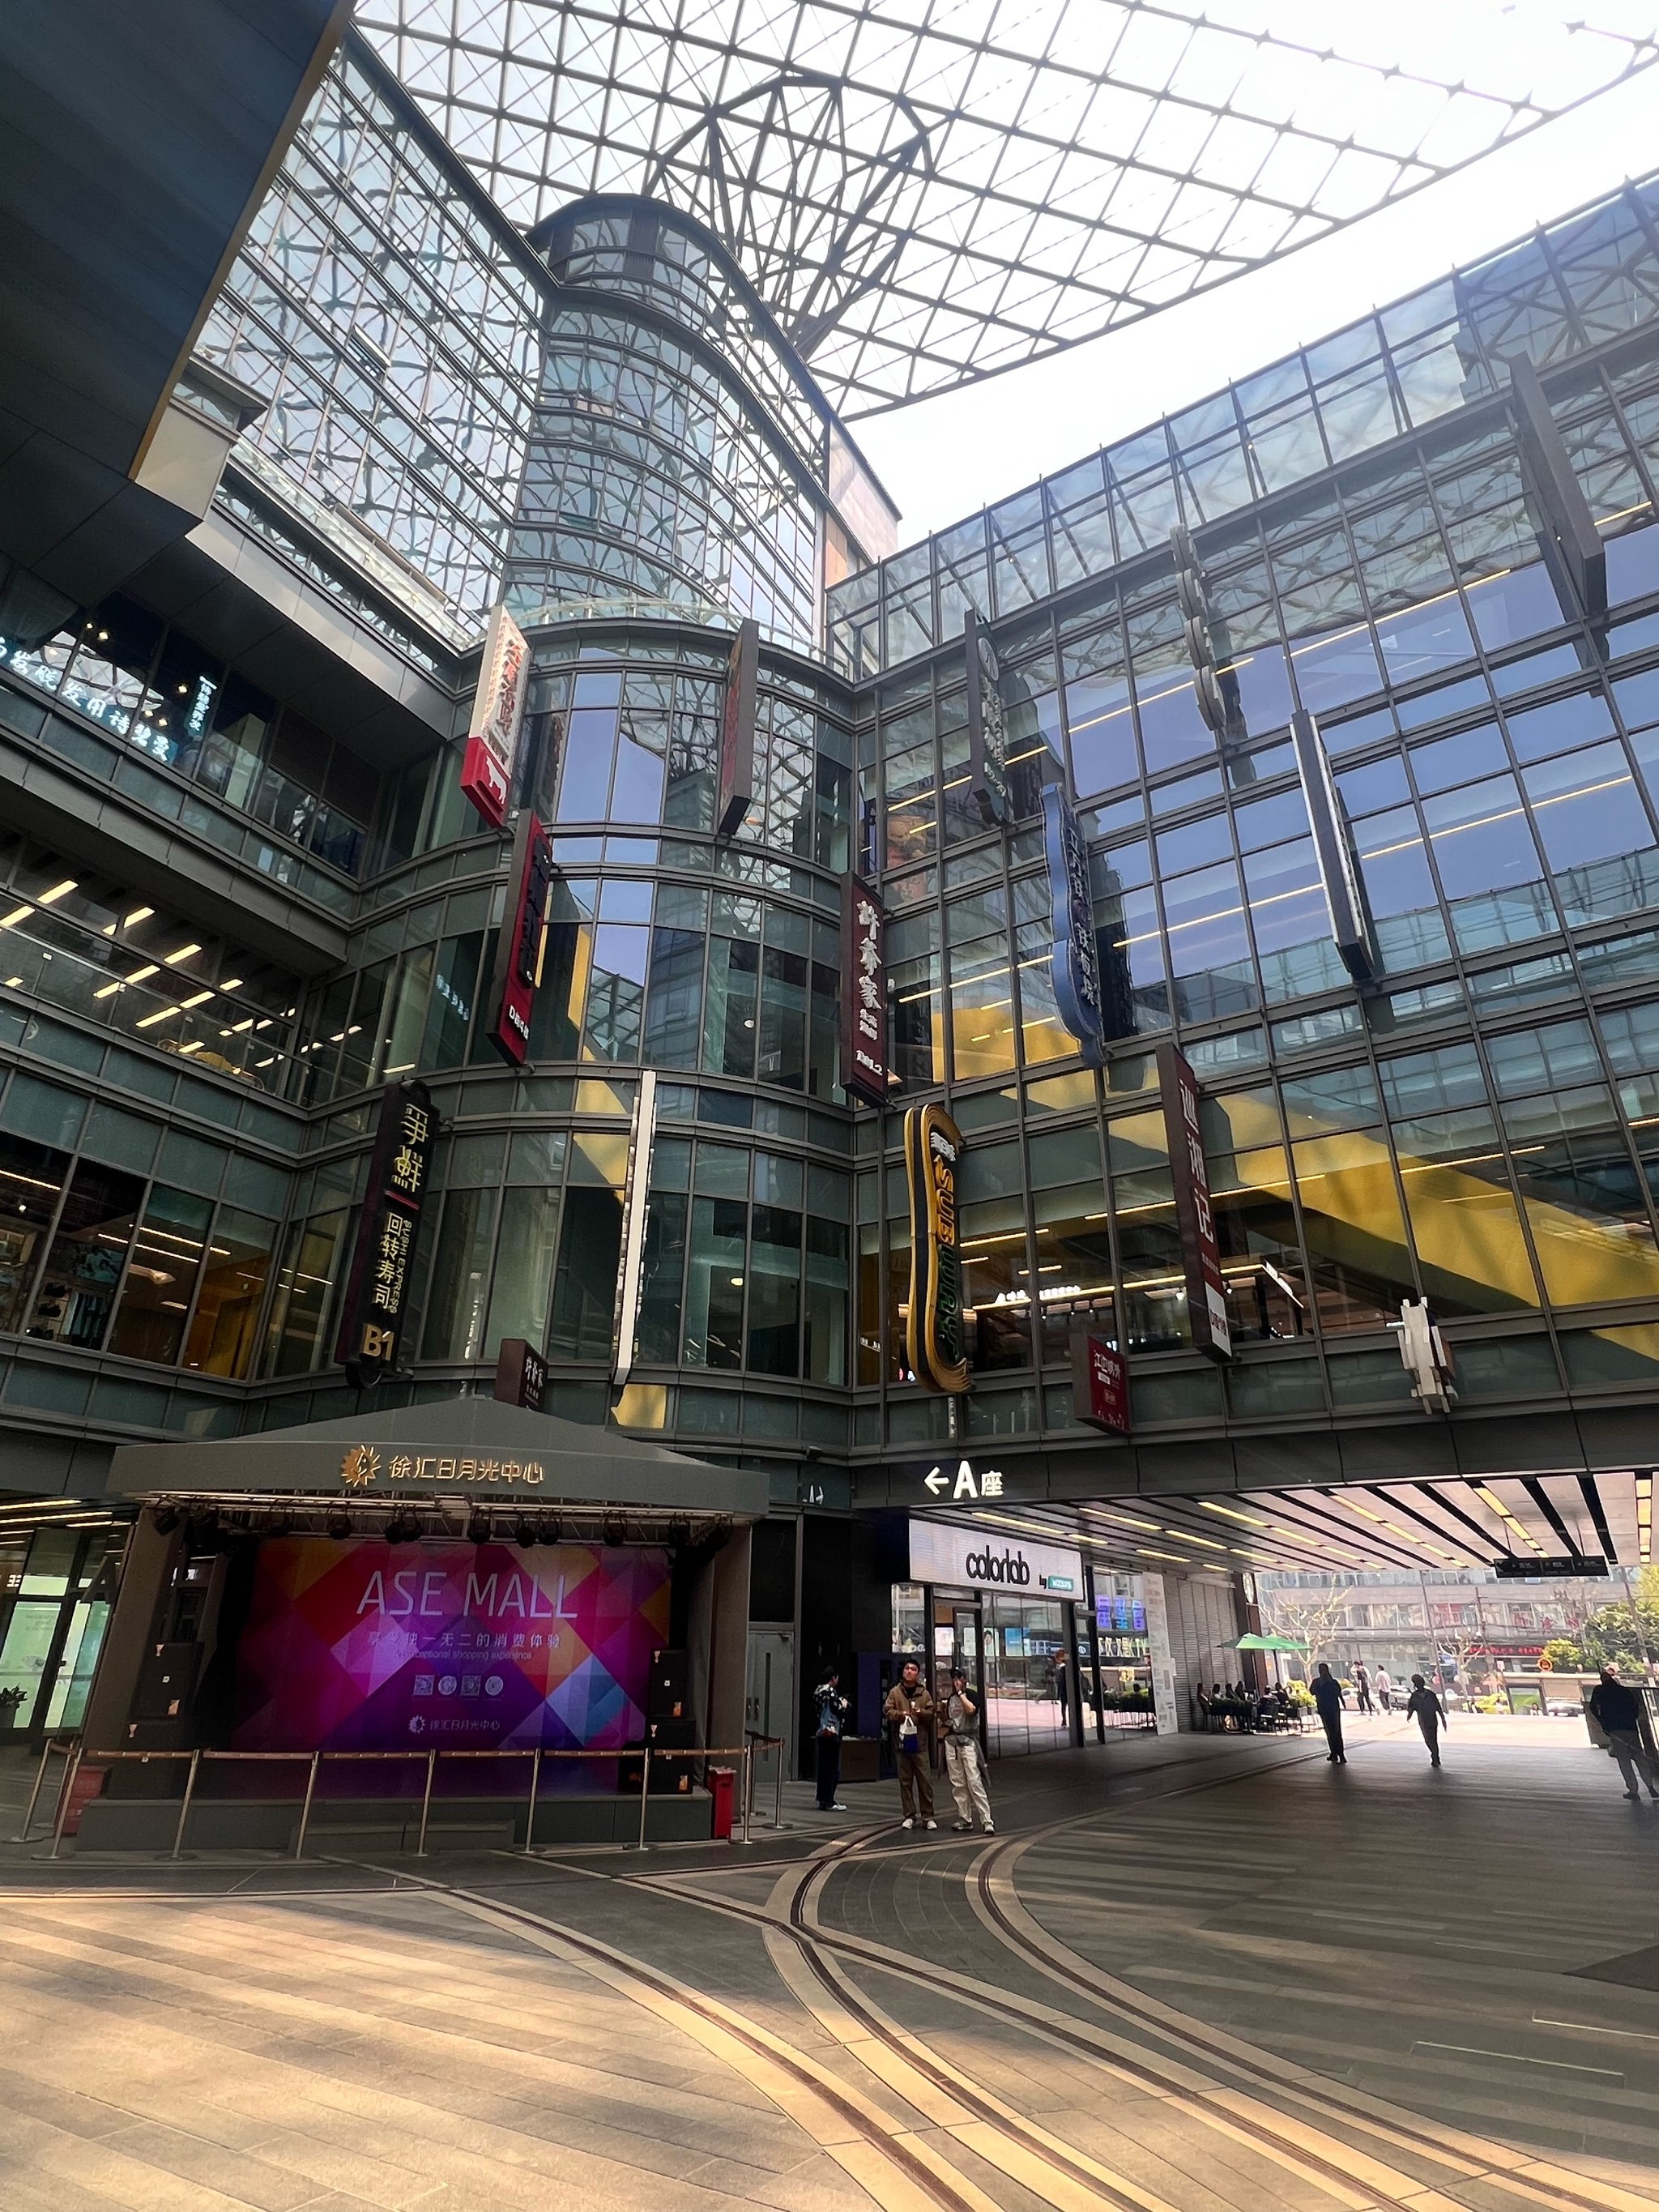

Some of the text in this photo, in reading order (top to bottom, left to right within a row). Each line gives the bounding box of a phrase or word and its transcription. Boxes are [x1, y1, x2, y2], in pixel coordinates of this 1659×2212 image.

[373, 1211, 403, 1309] 回转寿司
[933, 1155, 959, 1361] SUBWAY
[390, 1258, 407, 1313] EXPRESS
[363, 1322, 395, 1361] B1
[389, 1455, 544, 1484] 徐汇日月光中心
[953, 1460, 1004, 1499] A座
[966, 1544, 1030, 1585] colorlab
[356, 1569, 578, 1619] ASE MALL
[367, 1631, 563, 1649] 享受独一无二的消费体验
[453, 1650, 489, 1661] shopping
[430, 1719, 501, 1731] 徐汇日月光中心
